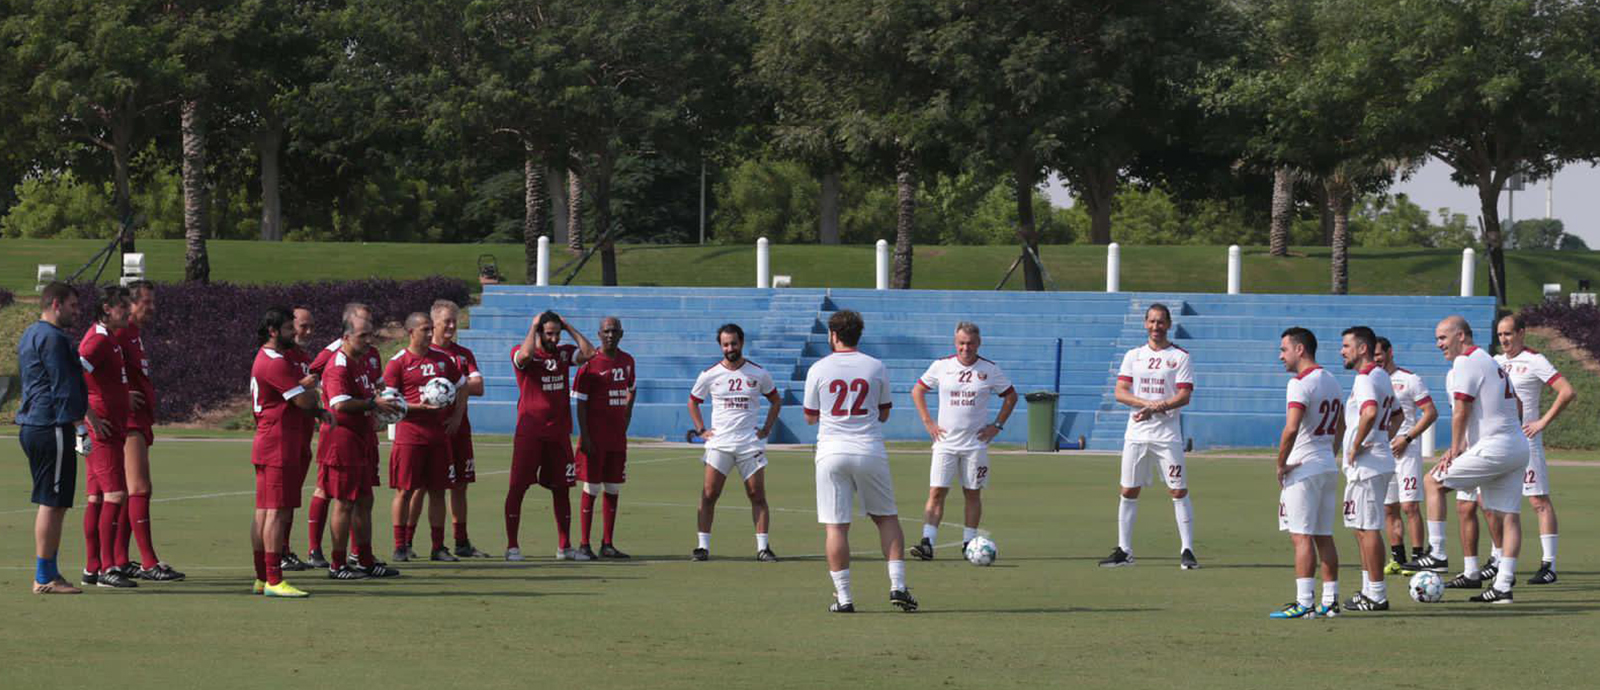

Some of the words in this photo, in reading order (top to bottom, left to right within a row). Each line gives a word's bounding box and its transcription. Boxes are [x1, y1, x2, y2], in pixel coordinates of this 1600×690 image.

[420, 364, 436, 376] 22
[545, 358, 557, 371] 22
[1148, 357, 1162, 370] 22
[612, 368, 625, 381] 22
[958, 371, 972, 383] 22
[728, 378, 743, 391] 22
[828, 378, 869, 416] 22
[1314, 398, 1340, 436] 22
[977, 466, 988, 479] 22
[1169, 465, 1182, 478] 22
[1523, 470, 1536, 484] 22
[1403, 477, 1417, 491] 22
[1343, 500, 1356, 515] 22
